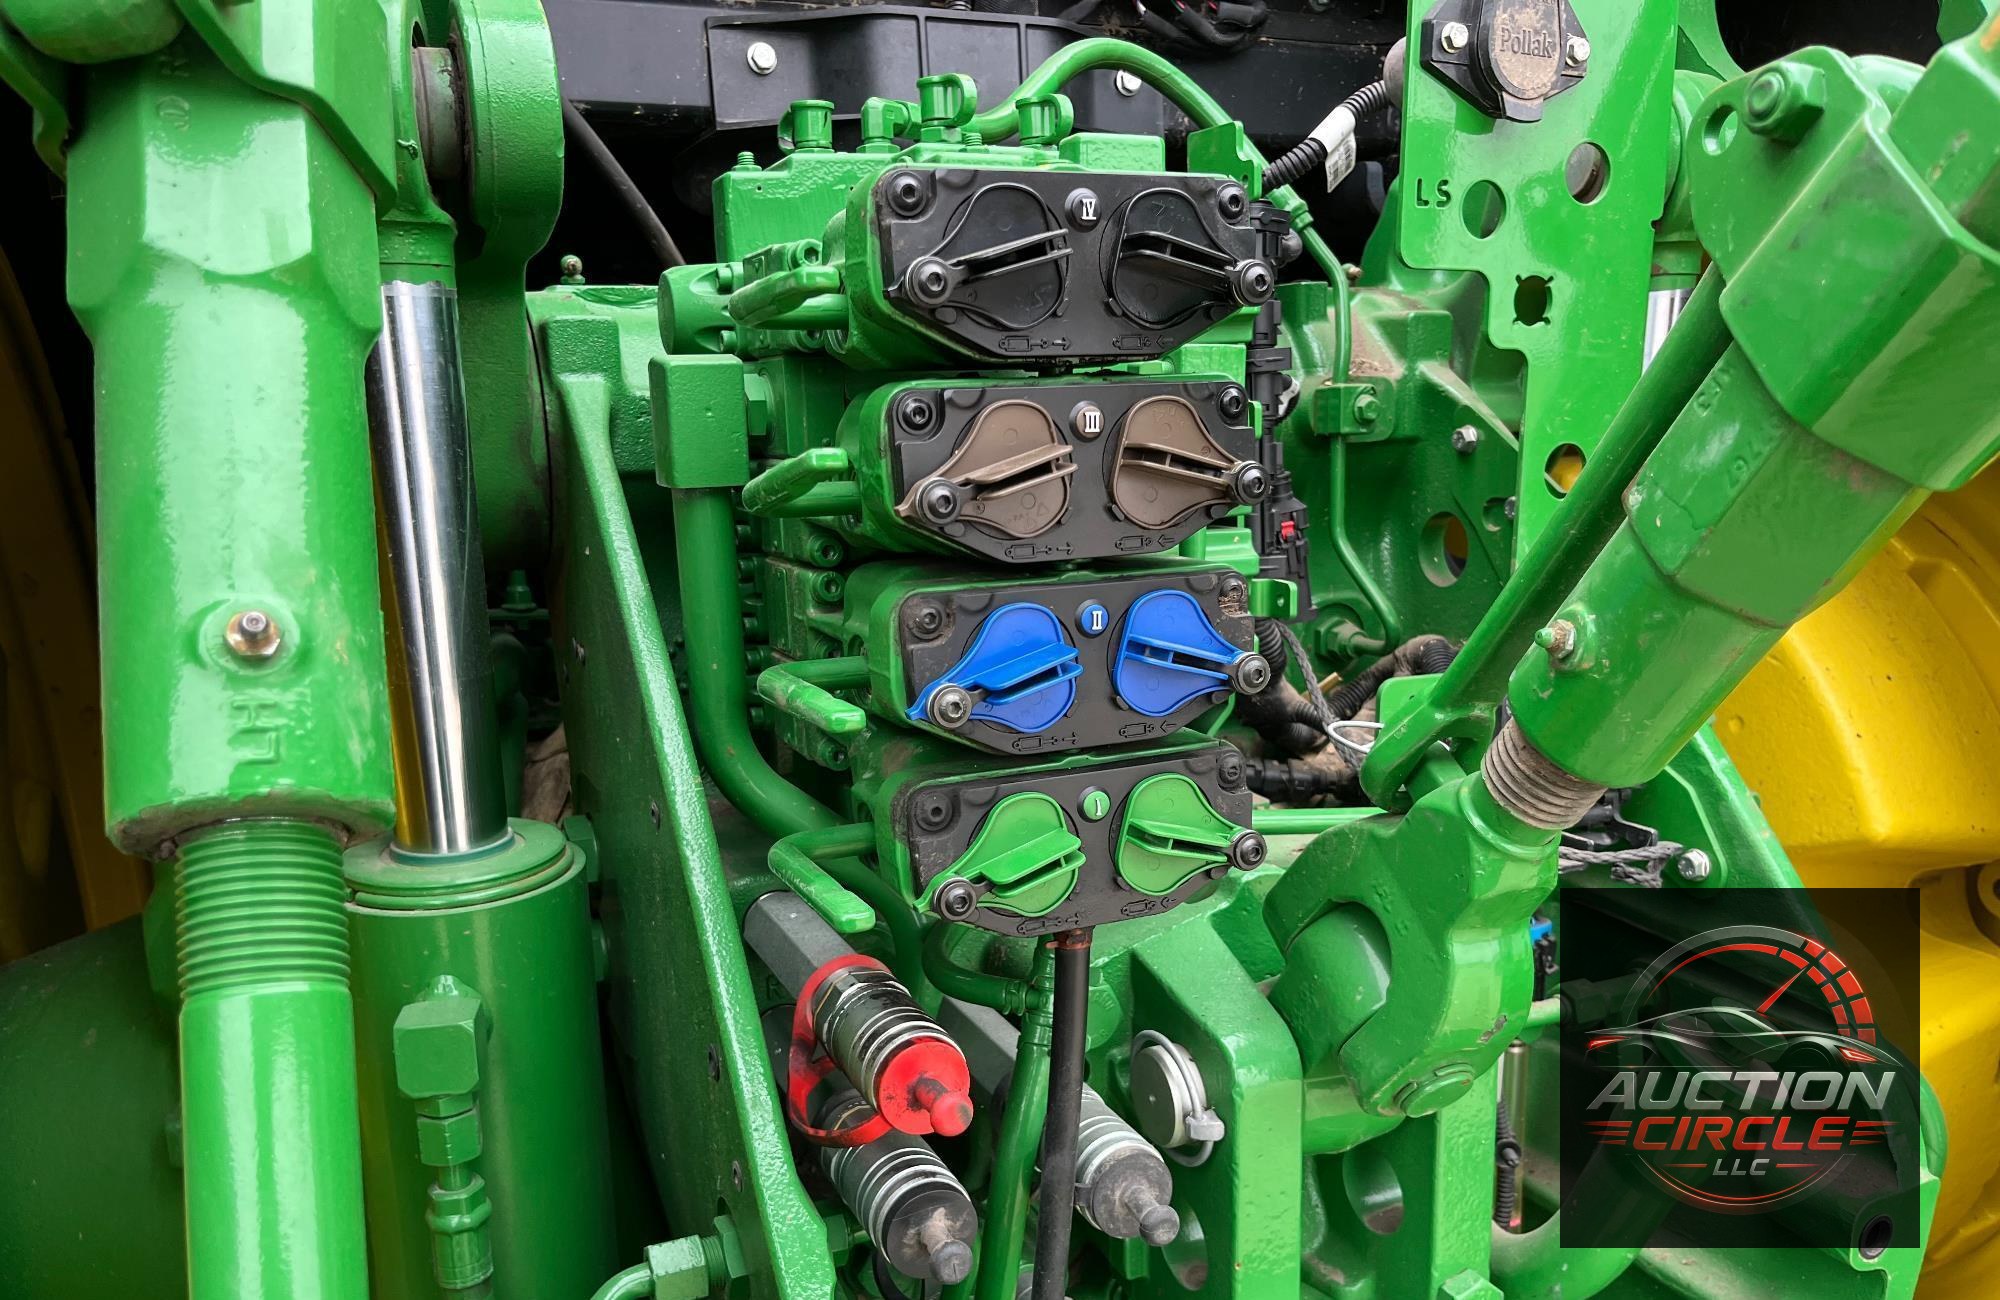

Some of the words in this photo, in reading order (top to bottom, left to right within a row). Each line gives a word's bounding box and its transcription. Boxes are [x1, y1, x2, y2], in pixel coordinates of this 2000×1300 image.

[1499, 26, 1552, 58] Pollak
[1416, 177, 1452, 209] LS
[1081, 198, 1097, 220] IV
[1084, 411, 1101, 433] III
[1092, 610, 1103, 630] II
